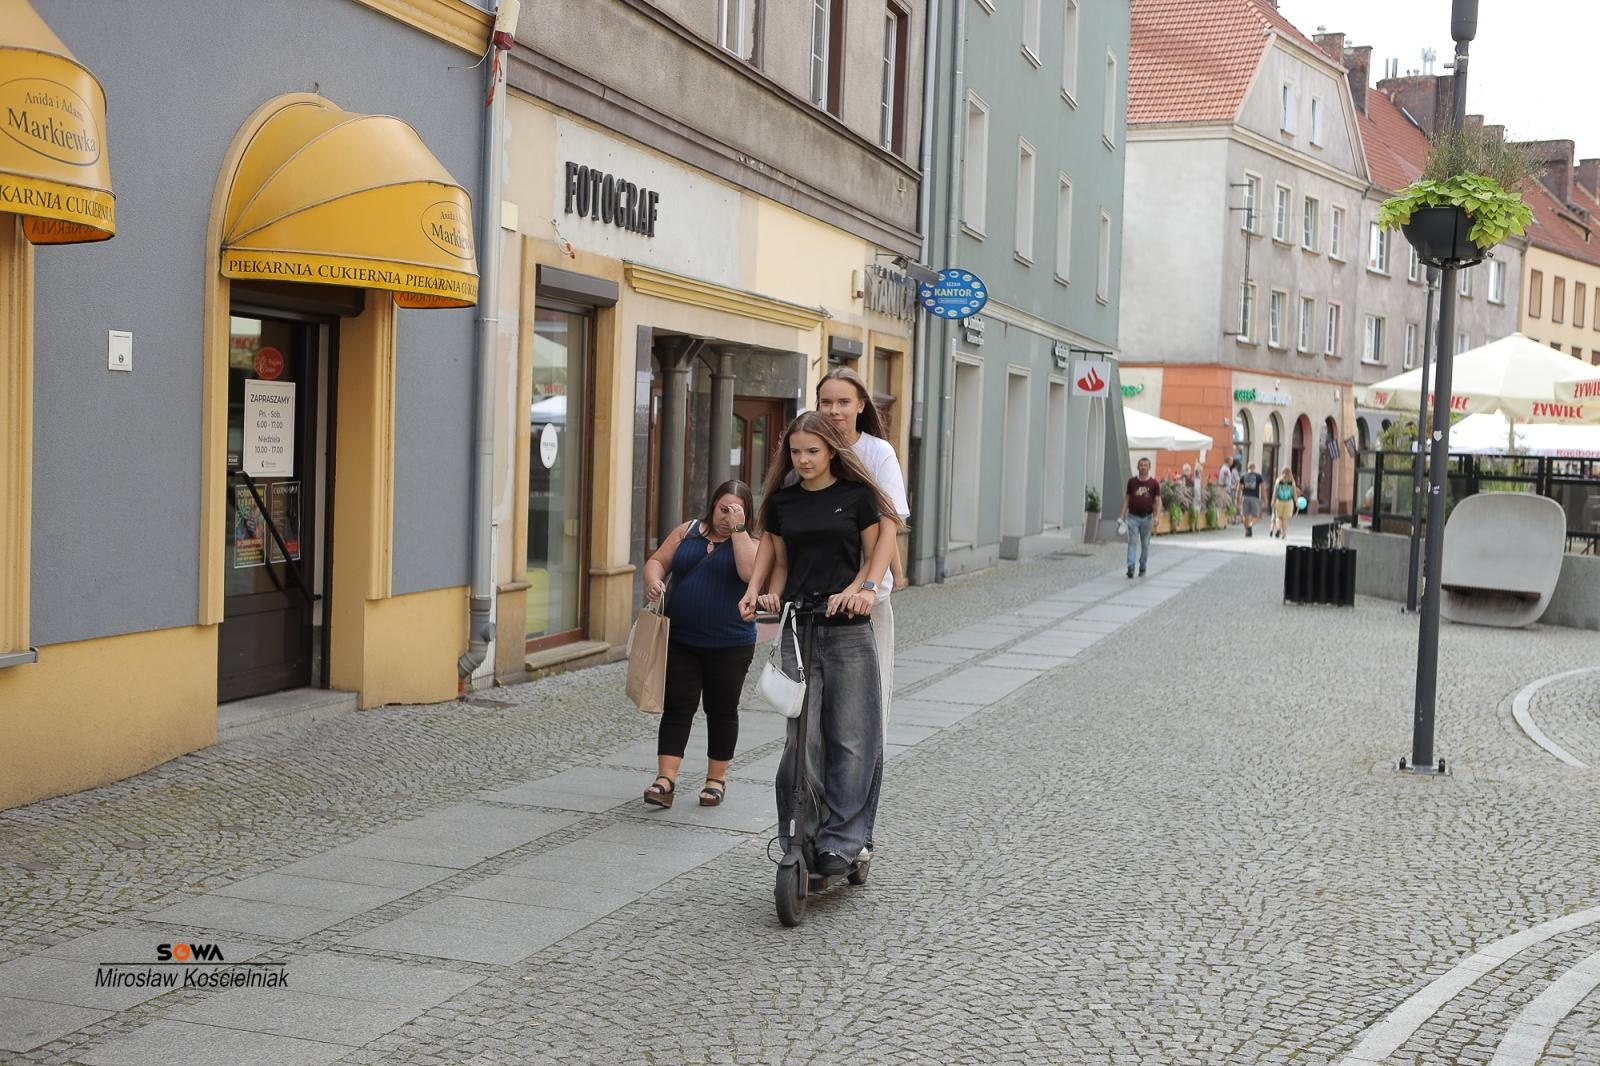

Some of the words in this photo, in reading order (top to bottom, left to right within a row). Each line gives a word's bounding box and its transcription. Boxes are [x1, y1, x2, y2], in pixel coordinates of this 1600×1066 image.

[25, 92, 53, 107] Anida
[62, 100, 84, 121] Adam
[8, 107, 96, 152] Markiewka
[66, 195, 113, 222] CUKIERNIA
[564, 161, 660, 237] FOTOGRAF
[228, 260, 313, 276] PIEKARNIA
[318, 264, 401, 284] CUKIERNIA
[405, 274, 460, 293] PIEKARNIA
[934, 288, 971, 297] KANTOR
[250, 394, 290, 404] ZAPRASZAMY
[258, 435, 281, 444] Niedziela
